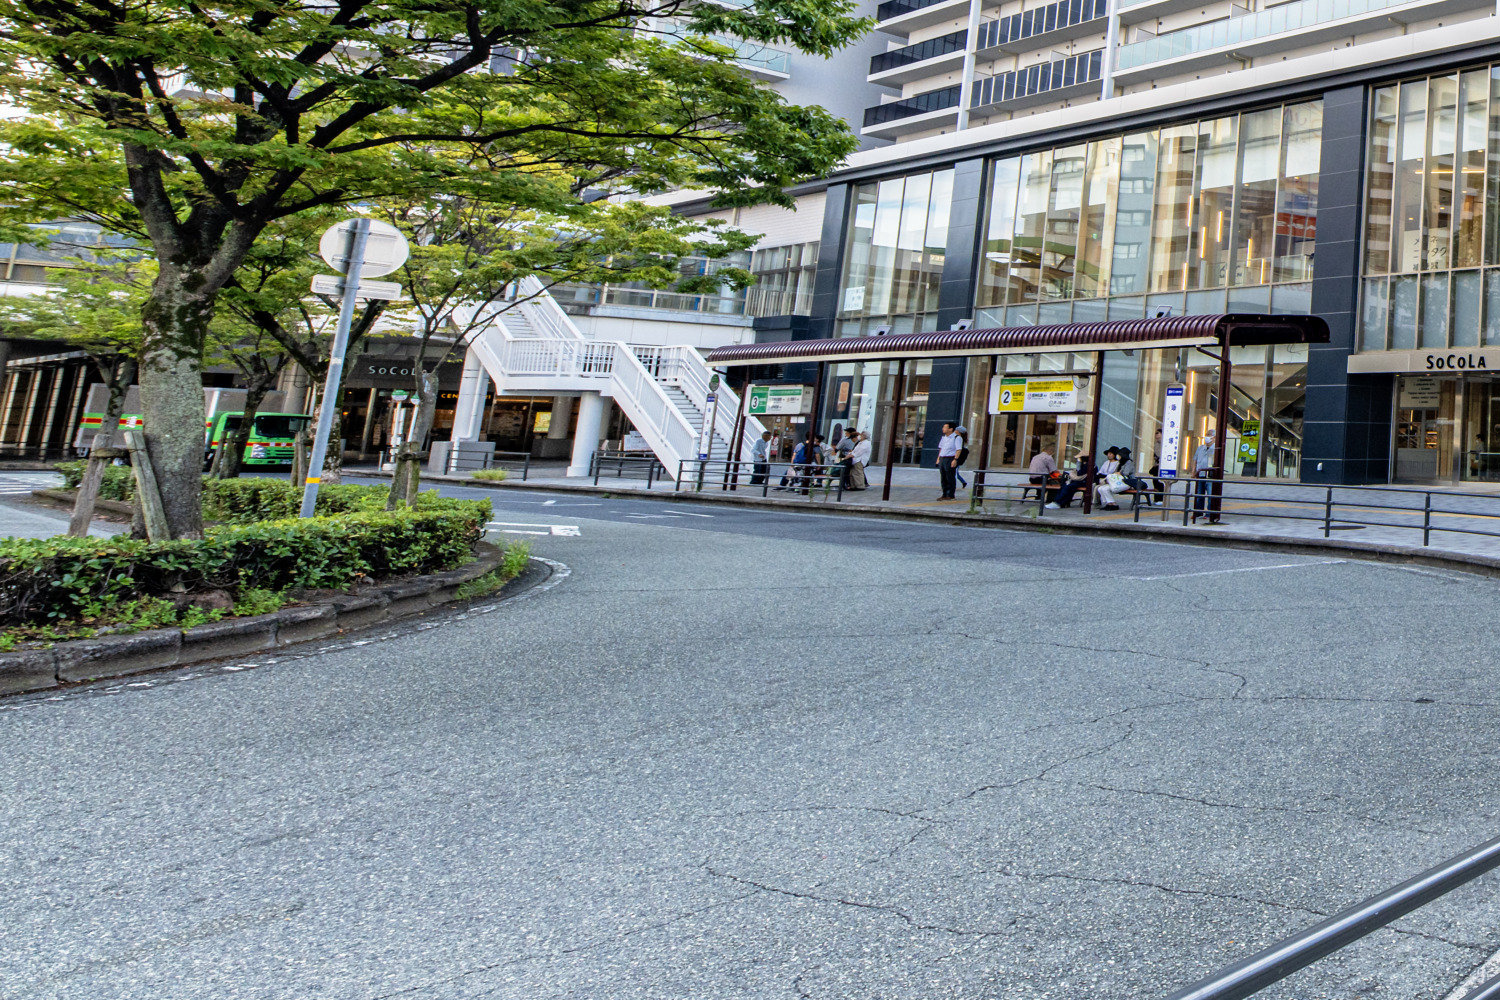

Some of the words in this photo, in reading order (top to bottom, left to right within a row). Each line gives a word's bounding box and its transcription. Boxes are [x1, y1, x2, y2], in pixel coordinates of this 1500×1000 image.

[1426, 353, 1487, 370] SoCoLA
[368, 365, 416, 376] SoCoL
[752, 396, 758, 408] 3
[1003, 391, 1010, 404] 2
